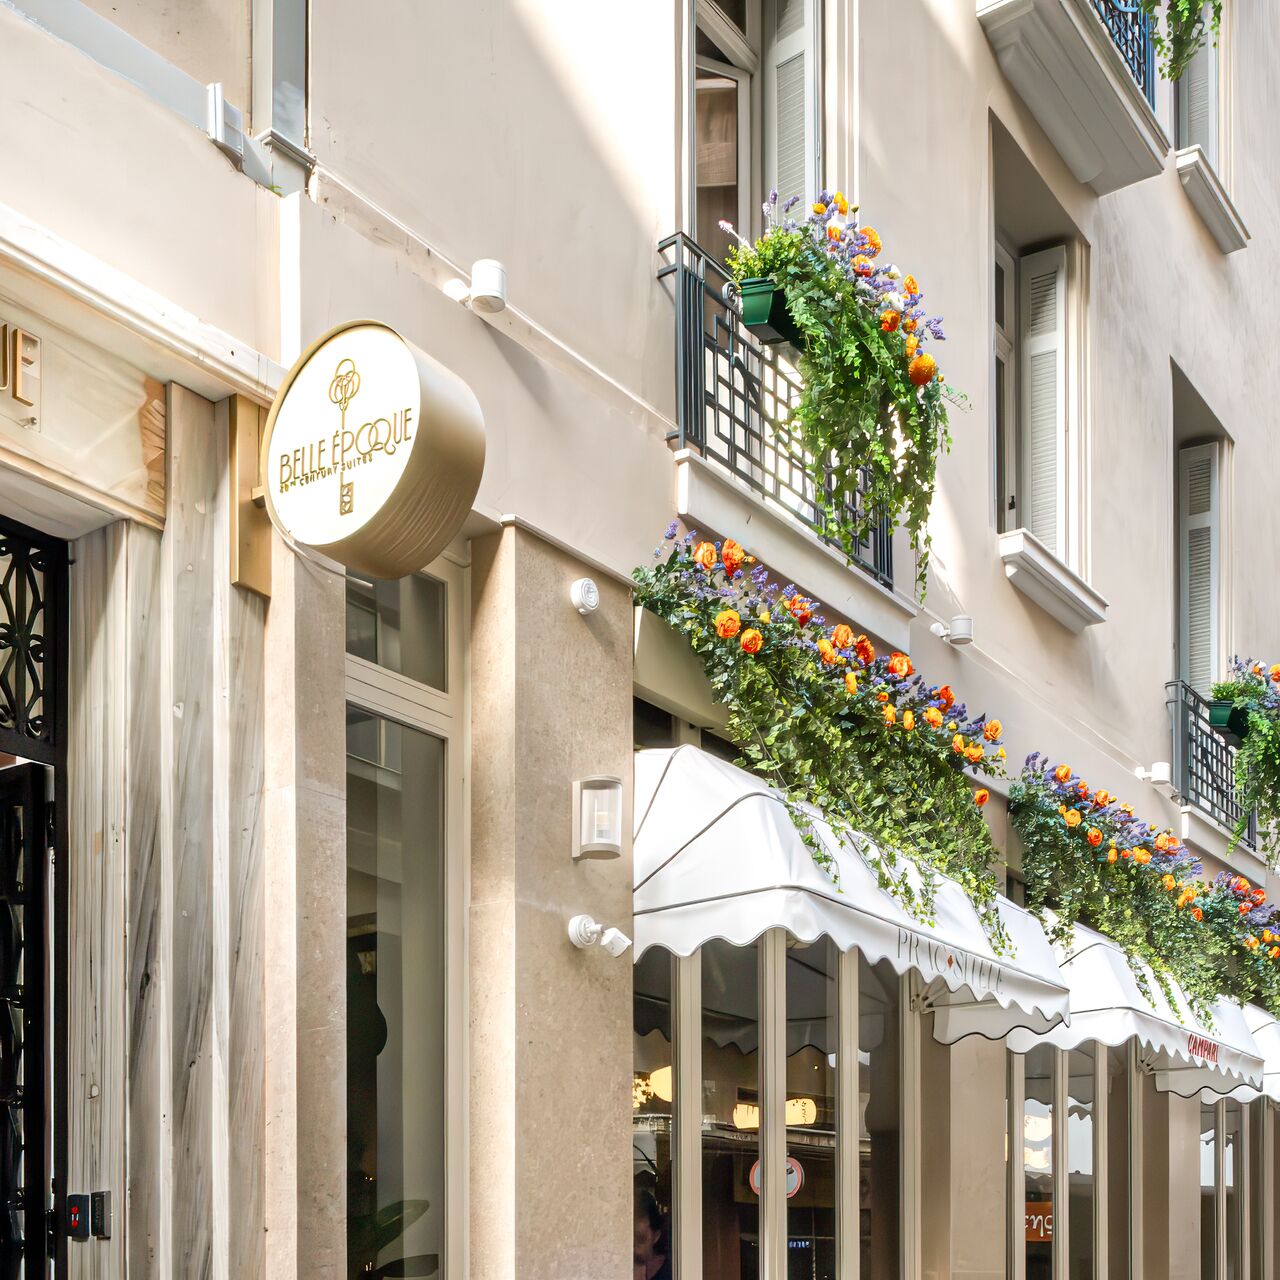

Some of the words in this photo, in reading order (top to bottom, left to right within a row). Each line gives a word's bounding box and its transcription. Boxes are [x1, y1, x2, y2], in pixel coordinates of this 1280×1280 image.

[279, 439, 326, 484] BELLE
[332, 408, 412, 466] ÉPOQUE
[299, 466, 338, 487] CENTURY
[341, 452, 373, 472] SUITES
[1187, 1033, 1219, 1063] CAMPARI
